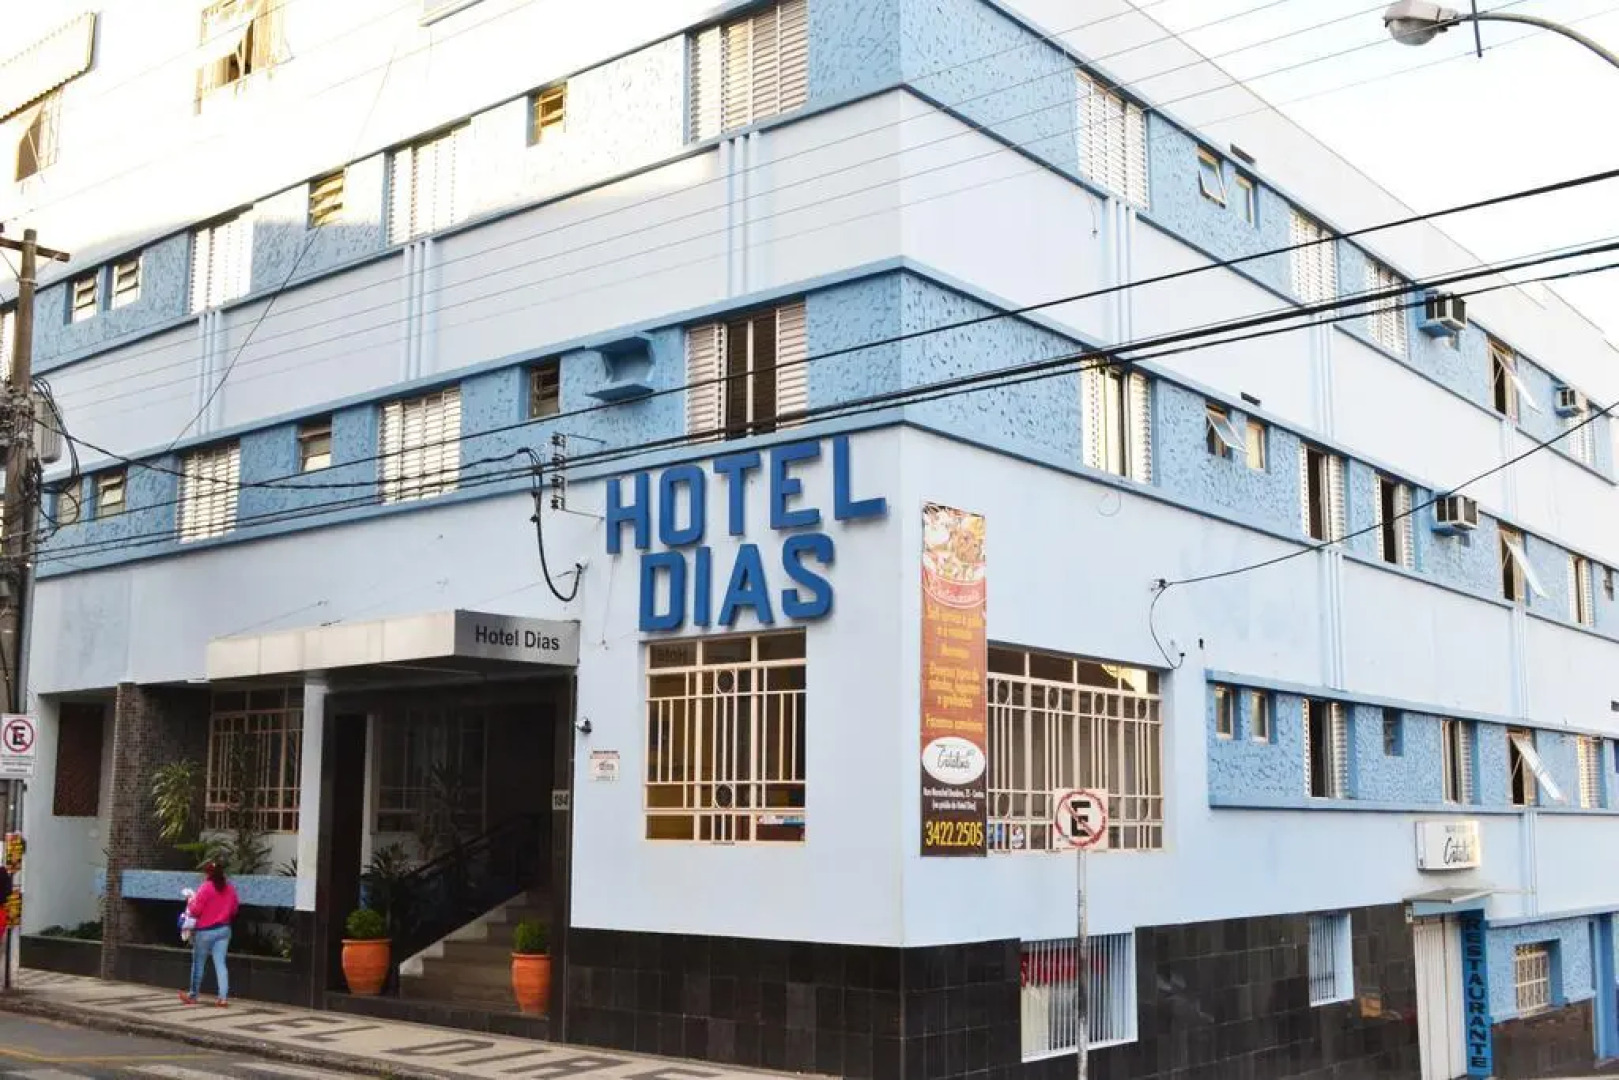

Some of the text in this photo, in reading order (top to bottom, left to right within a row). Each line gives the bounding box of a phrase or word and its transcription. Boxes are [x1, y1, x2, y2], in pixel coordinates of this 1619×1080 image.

[606, 435, 887, 554] HOTEL
[639, 532, 834, 631] DIAS
[475, 624, 560, 651] Hotel Dias
[925, 820, 983, 847] 3422.2505
[1465, 917, 1488, 1068] RESTAURANTE
